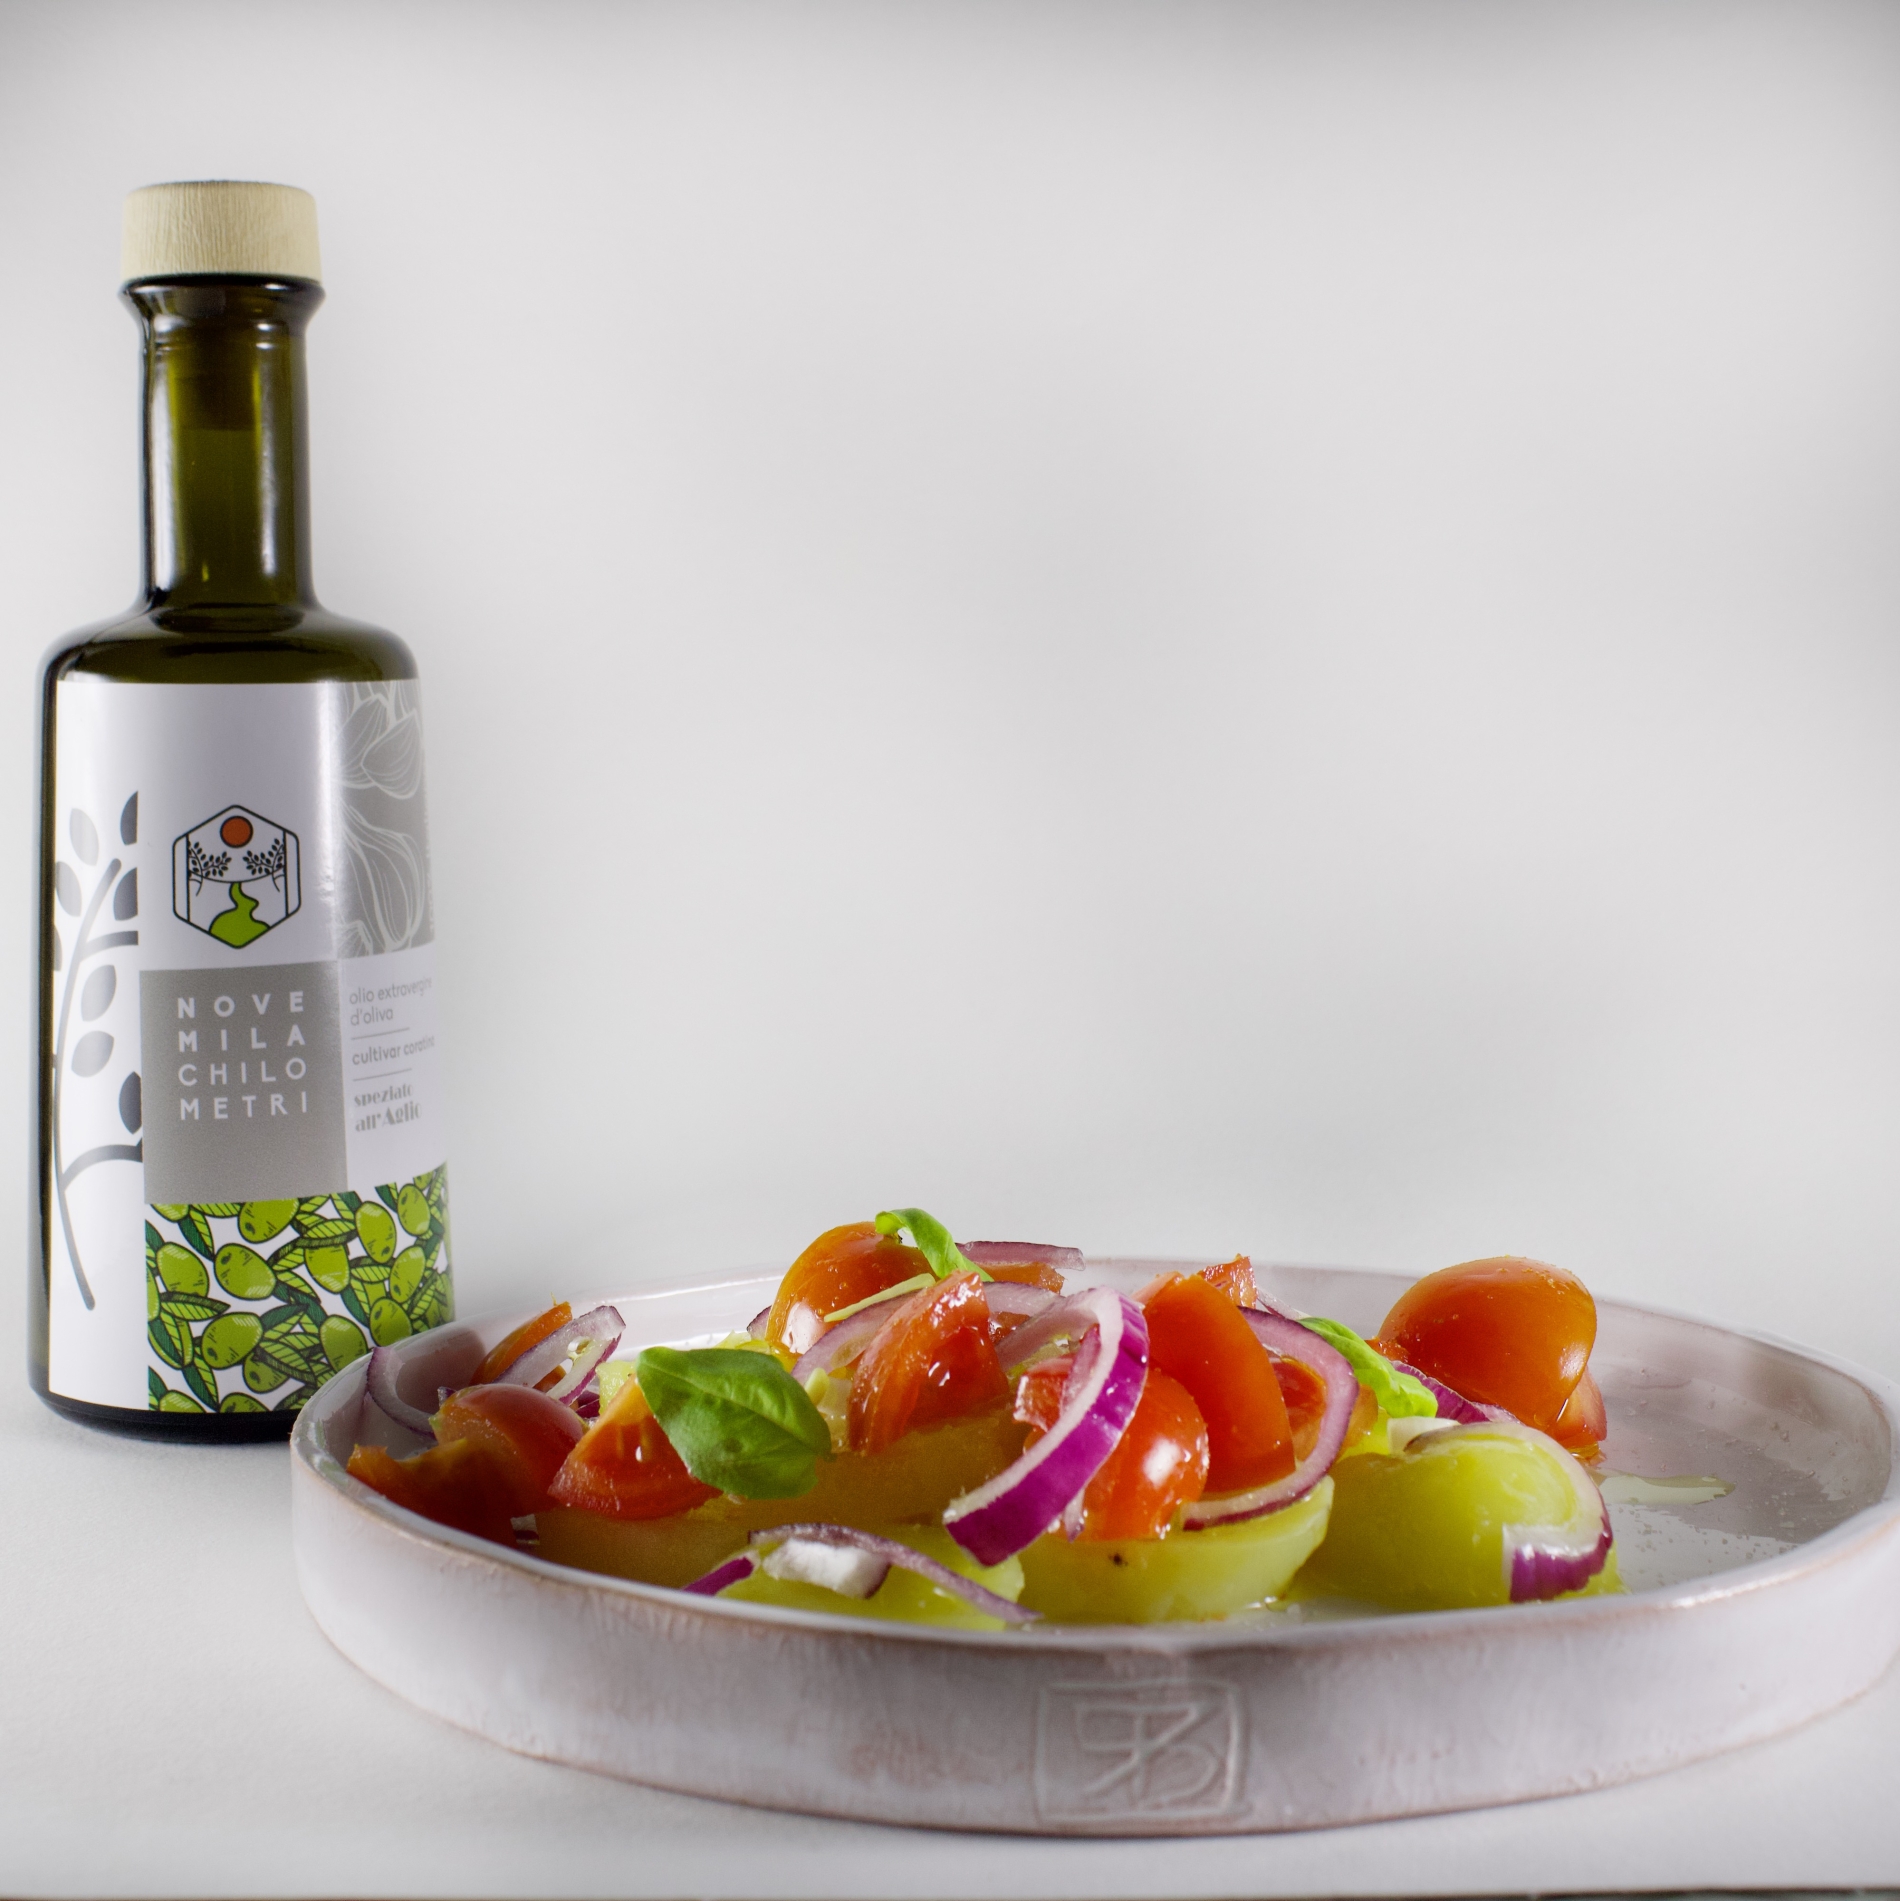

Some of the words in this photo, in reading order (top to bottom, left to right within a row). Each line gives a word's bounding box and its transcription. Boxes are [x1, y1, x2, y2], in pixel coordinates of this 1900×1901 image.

[177, 991, 304, 1019] NOVE
[349, 986, 375, 1005] olio
[350, 1005, 394, 1026] d'oliva
[178, 1024, 306, 1052] MILA
[352, 1046, 402, 1065] cultivar
[178, 1057, 307, 1086] CHILO
[180, 1092, 308, 1120] METRI
[354, 1083, 414, 1107] speziato
